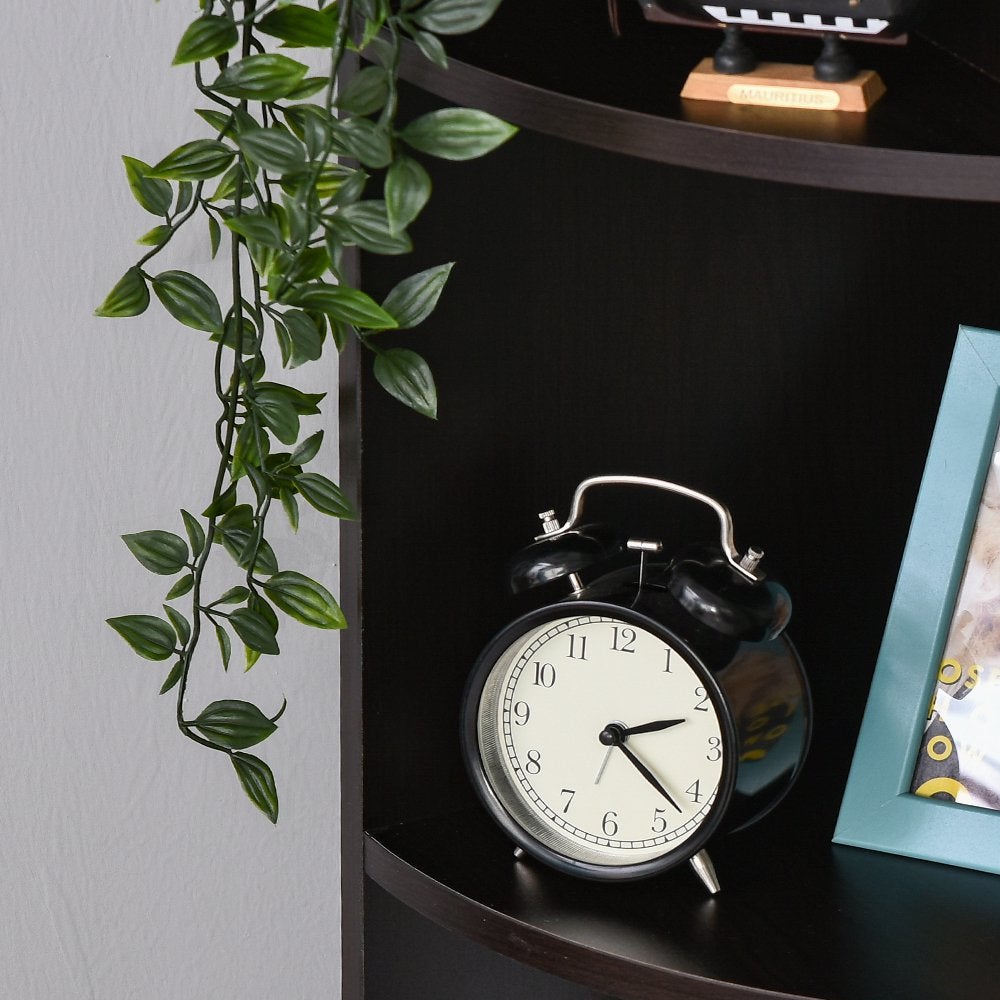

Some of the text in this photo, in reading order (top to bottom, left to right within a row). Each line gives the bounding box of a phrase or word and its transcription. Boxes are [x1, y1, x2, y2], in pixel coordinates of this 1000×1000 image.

[740, 87, 825, 105] MAURITIUS
[566, 633, 588, 661] 11
[609, 626, 637, 654] 12
[662, 648, 673, 673] 1
[532, 661, 556, 688] 10
[694, 686, 709, 712] 2
[514, 701, 530, 726] 9
[525, 749, 541, 774] 8
[706, 736, 722, 762] 3
[560, 788, 576, 813] 7
[685, 779, 703, 803] 4
[602, 811, 618, 836] 6
[651, 808, 667, 833] 5
